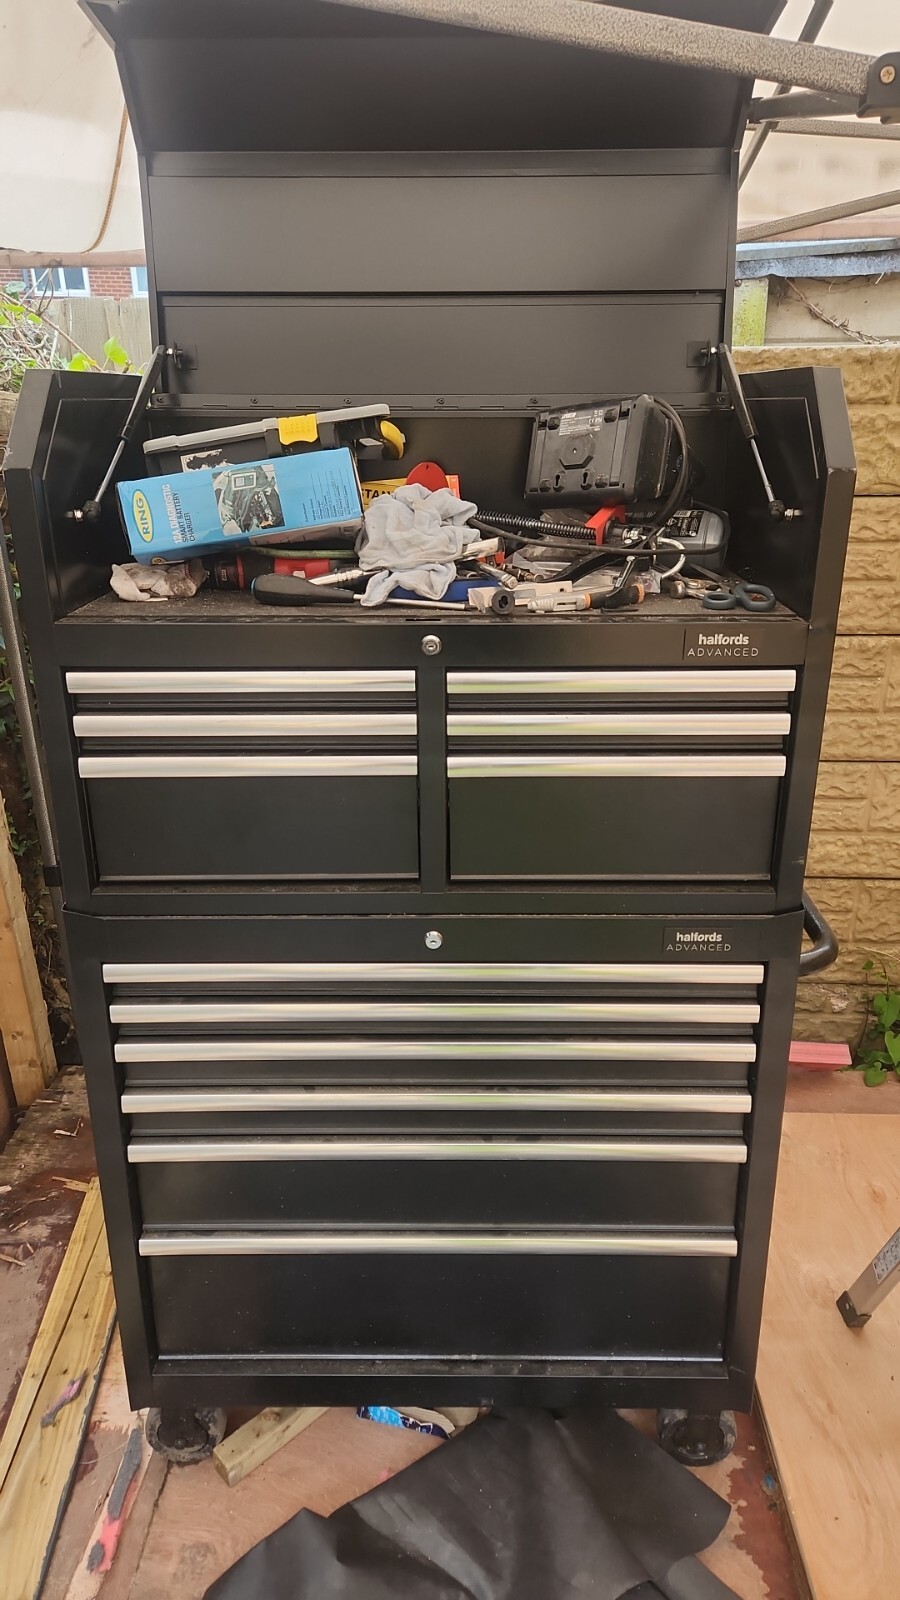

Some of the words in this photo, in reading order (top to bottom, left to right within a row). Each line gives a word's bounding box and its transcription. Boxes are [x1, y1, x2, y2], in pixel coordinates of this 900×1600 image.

[162, 484, 178, 529] DIAGNOSTIC
[172, 492, 183, 520] BATTERY
[136, 497, 150, 535] RING
[172, 528, 182, 544] 12A
[178, 521, 188, 543] SMART
[184, 512, 195, 542] CHARGER
[698, 633, 750, 645] halfords
[687, 647, 759, 657] ADVANCED
[676, 932, 723, 942] halfords
[666, 943, 732, 952] ADVANCED
